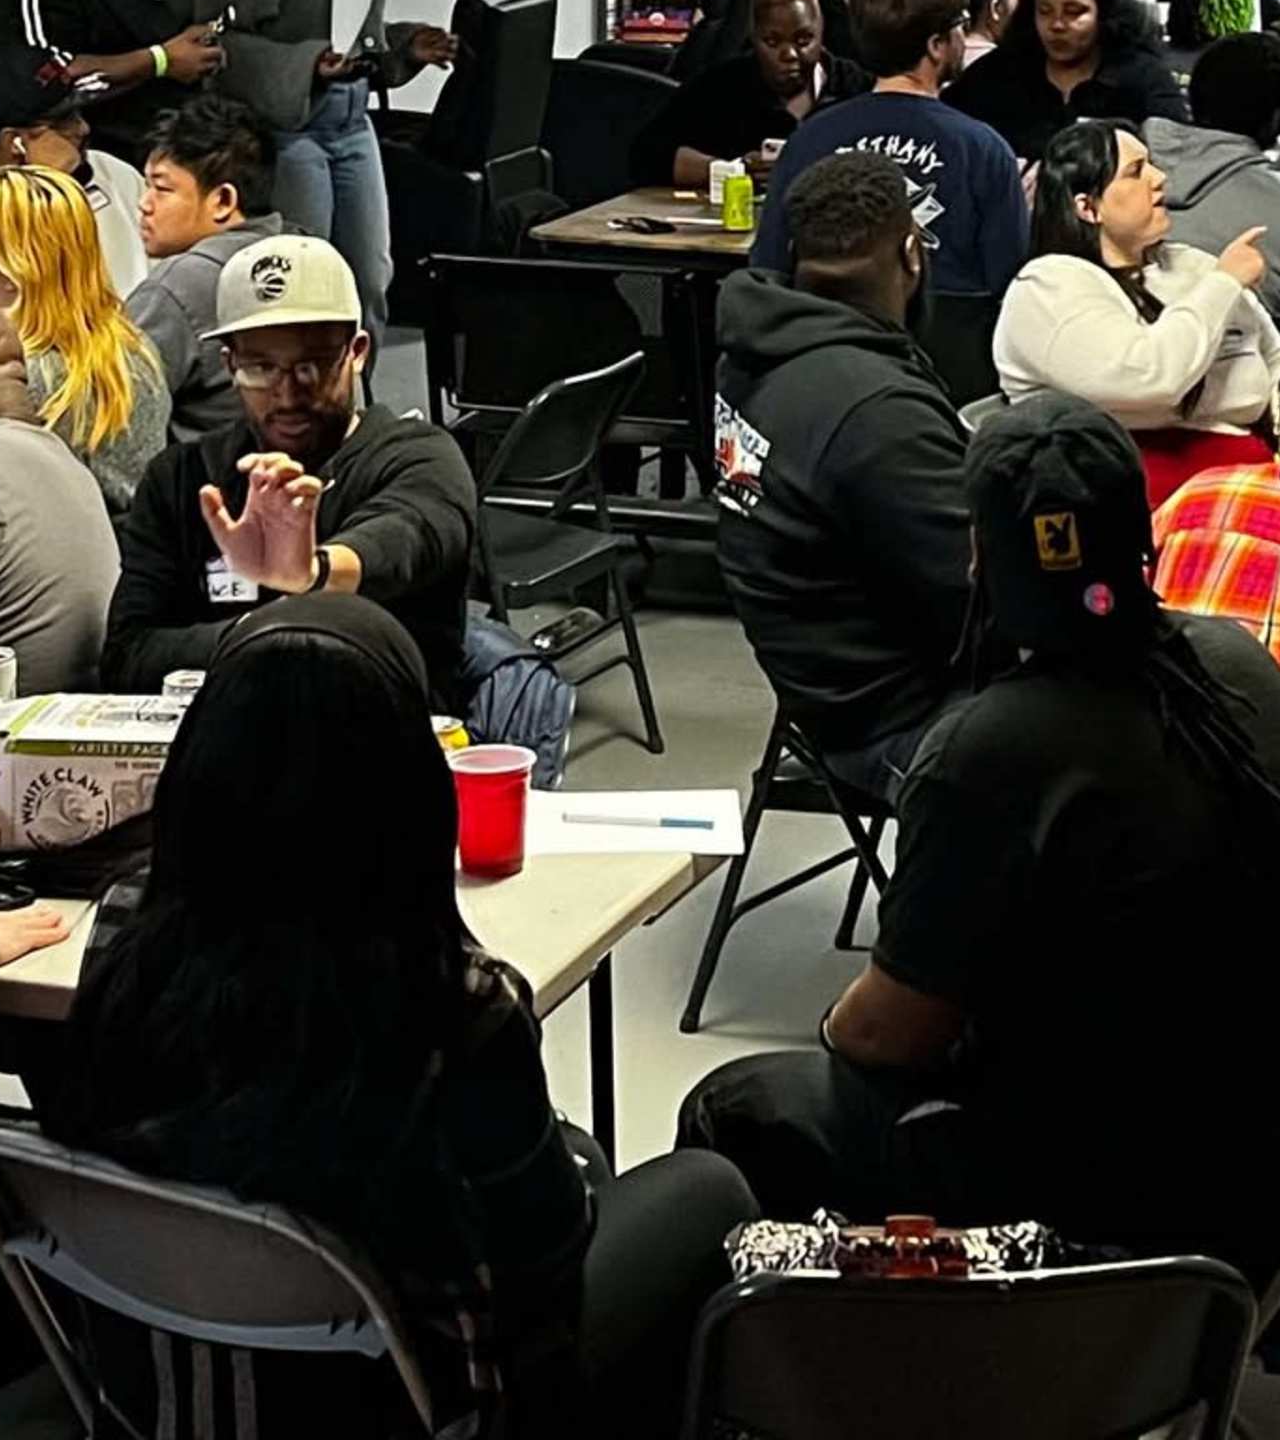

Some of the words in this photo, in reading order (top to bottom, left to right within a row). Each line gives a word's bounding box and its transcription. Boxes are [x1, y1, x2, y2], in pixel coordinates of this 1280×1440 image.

[70, 741, 129, 756] VARIETY
[22, 772, 52, 825] WHITE
[53, 767, 105, 799] CLAW
